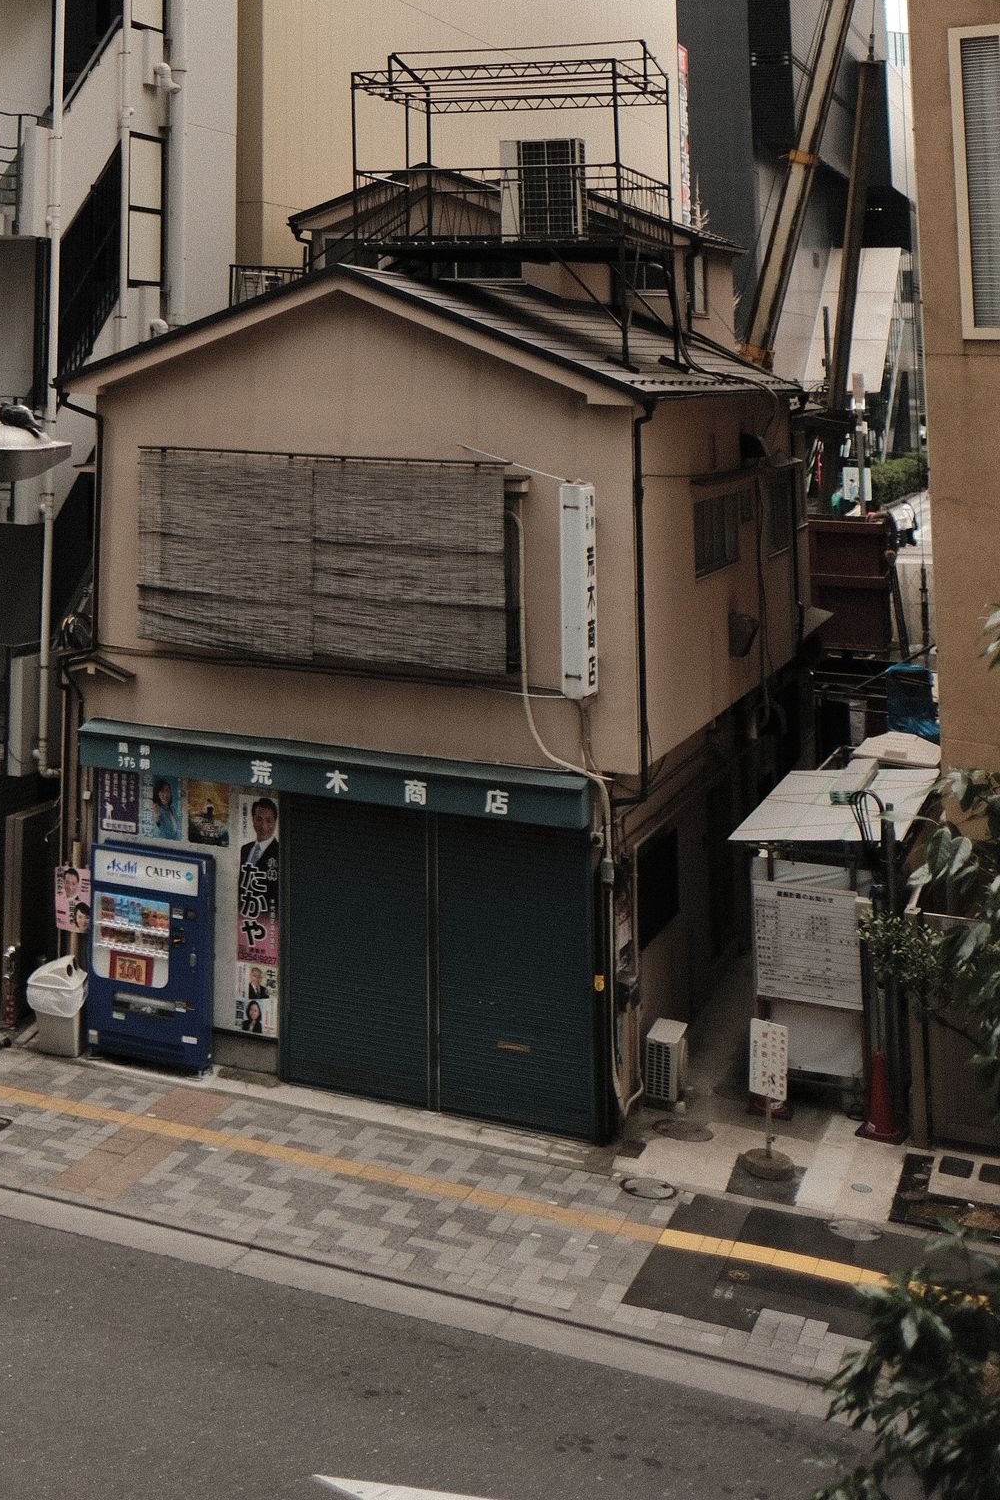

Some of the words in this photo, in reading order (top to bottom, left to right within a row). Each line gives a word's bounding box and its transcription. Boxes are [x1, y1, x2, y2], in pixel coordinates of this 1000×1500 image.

[250, 759, 509, 816] 荒木商店
[106, 858, 138, 874] Asahi
[145, 865, 182, 880] CALPIS
[240, 862, 268, 947] たかや
